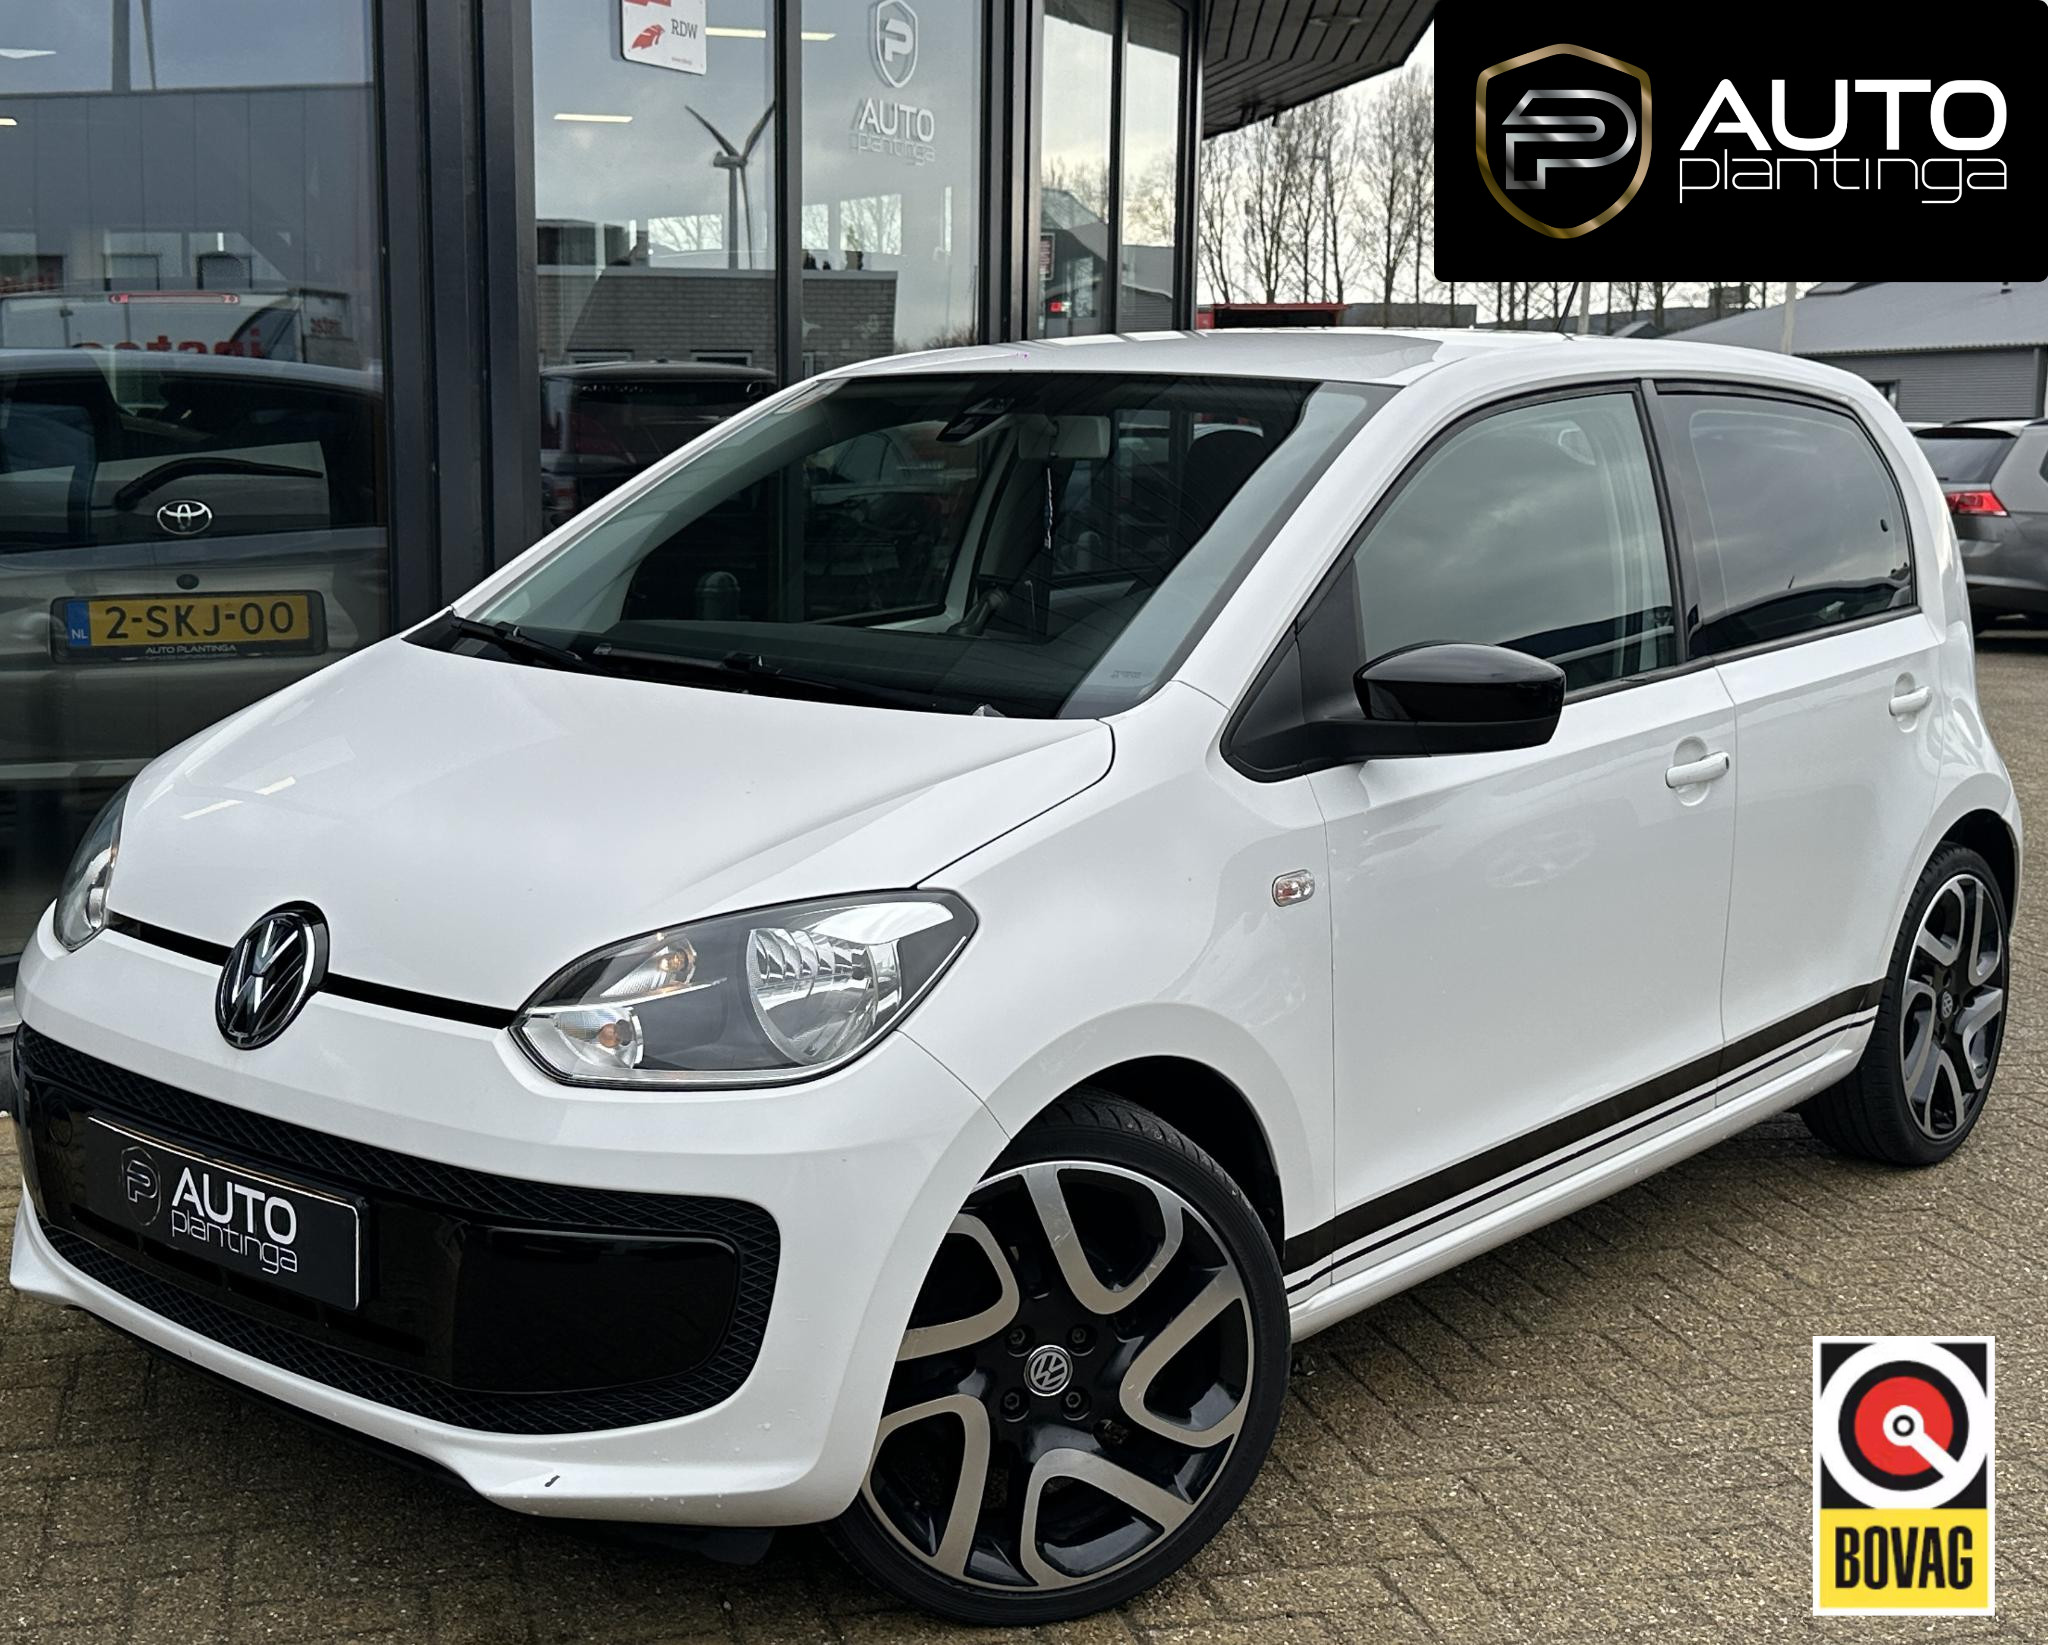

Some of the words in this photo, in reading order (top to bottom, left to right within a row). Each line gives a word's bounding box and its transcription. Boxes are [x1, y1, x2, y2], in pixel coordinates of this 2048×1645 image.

[671, 18, 698, 40] RDW
[859, 97, 934, 142] AUTO
[71, 629, 88, 640] NL
[105, 602, 294, 639] 2-SKJ-00
[146, 646, 175, 655] AUTO
[176, 644, 236, 654] PLANTINGA
[171, 1167, 297, 1245] AUTO
[171, 1209, 298, 1275] plantinga
